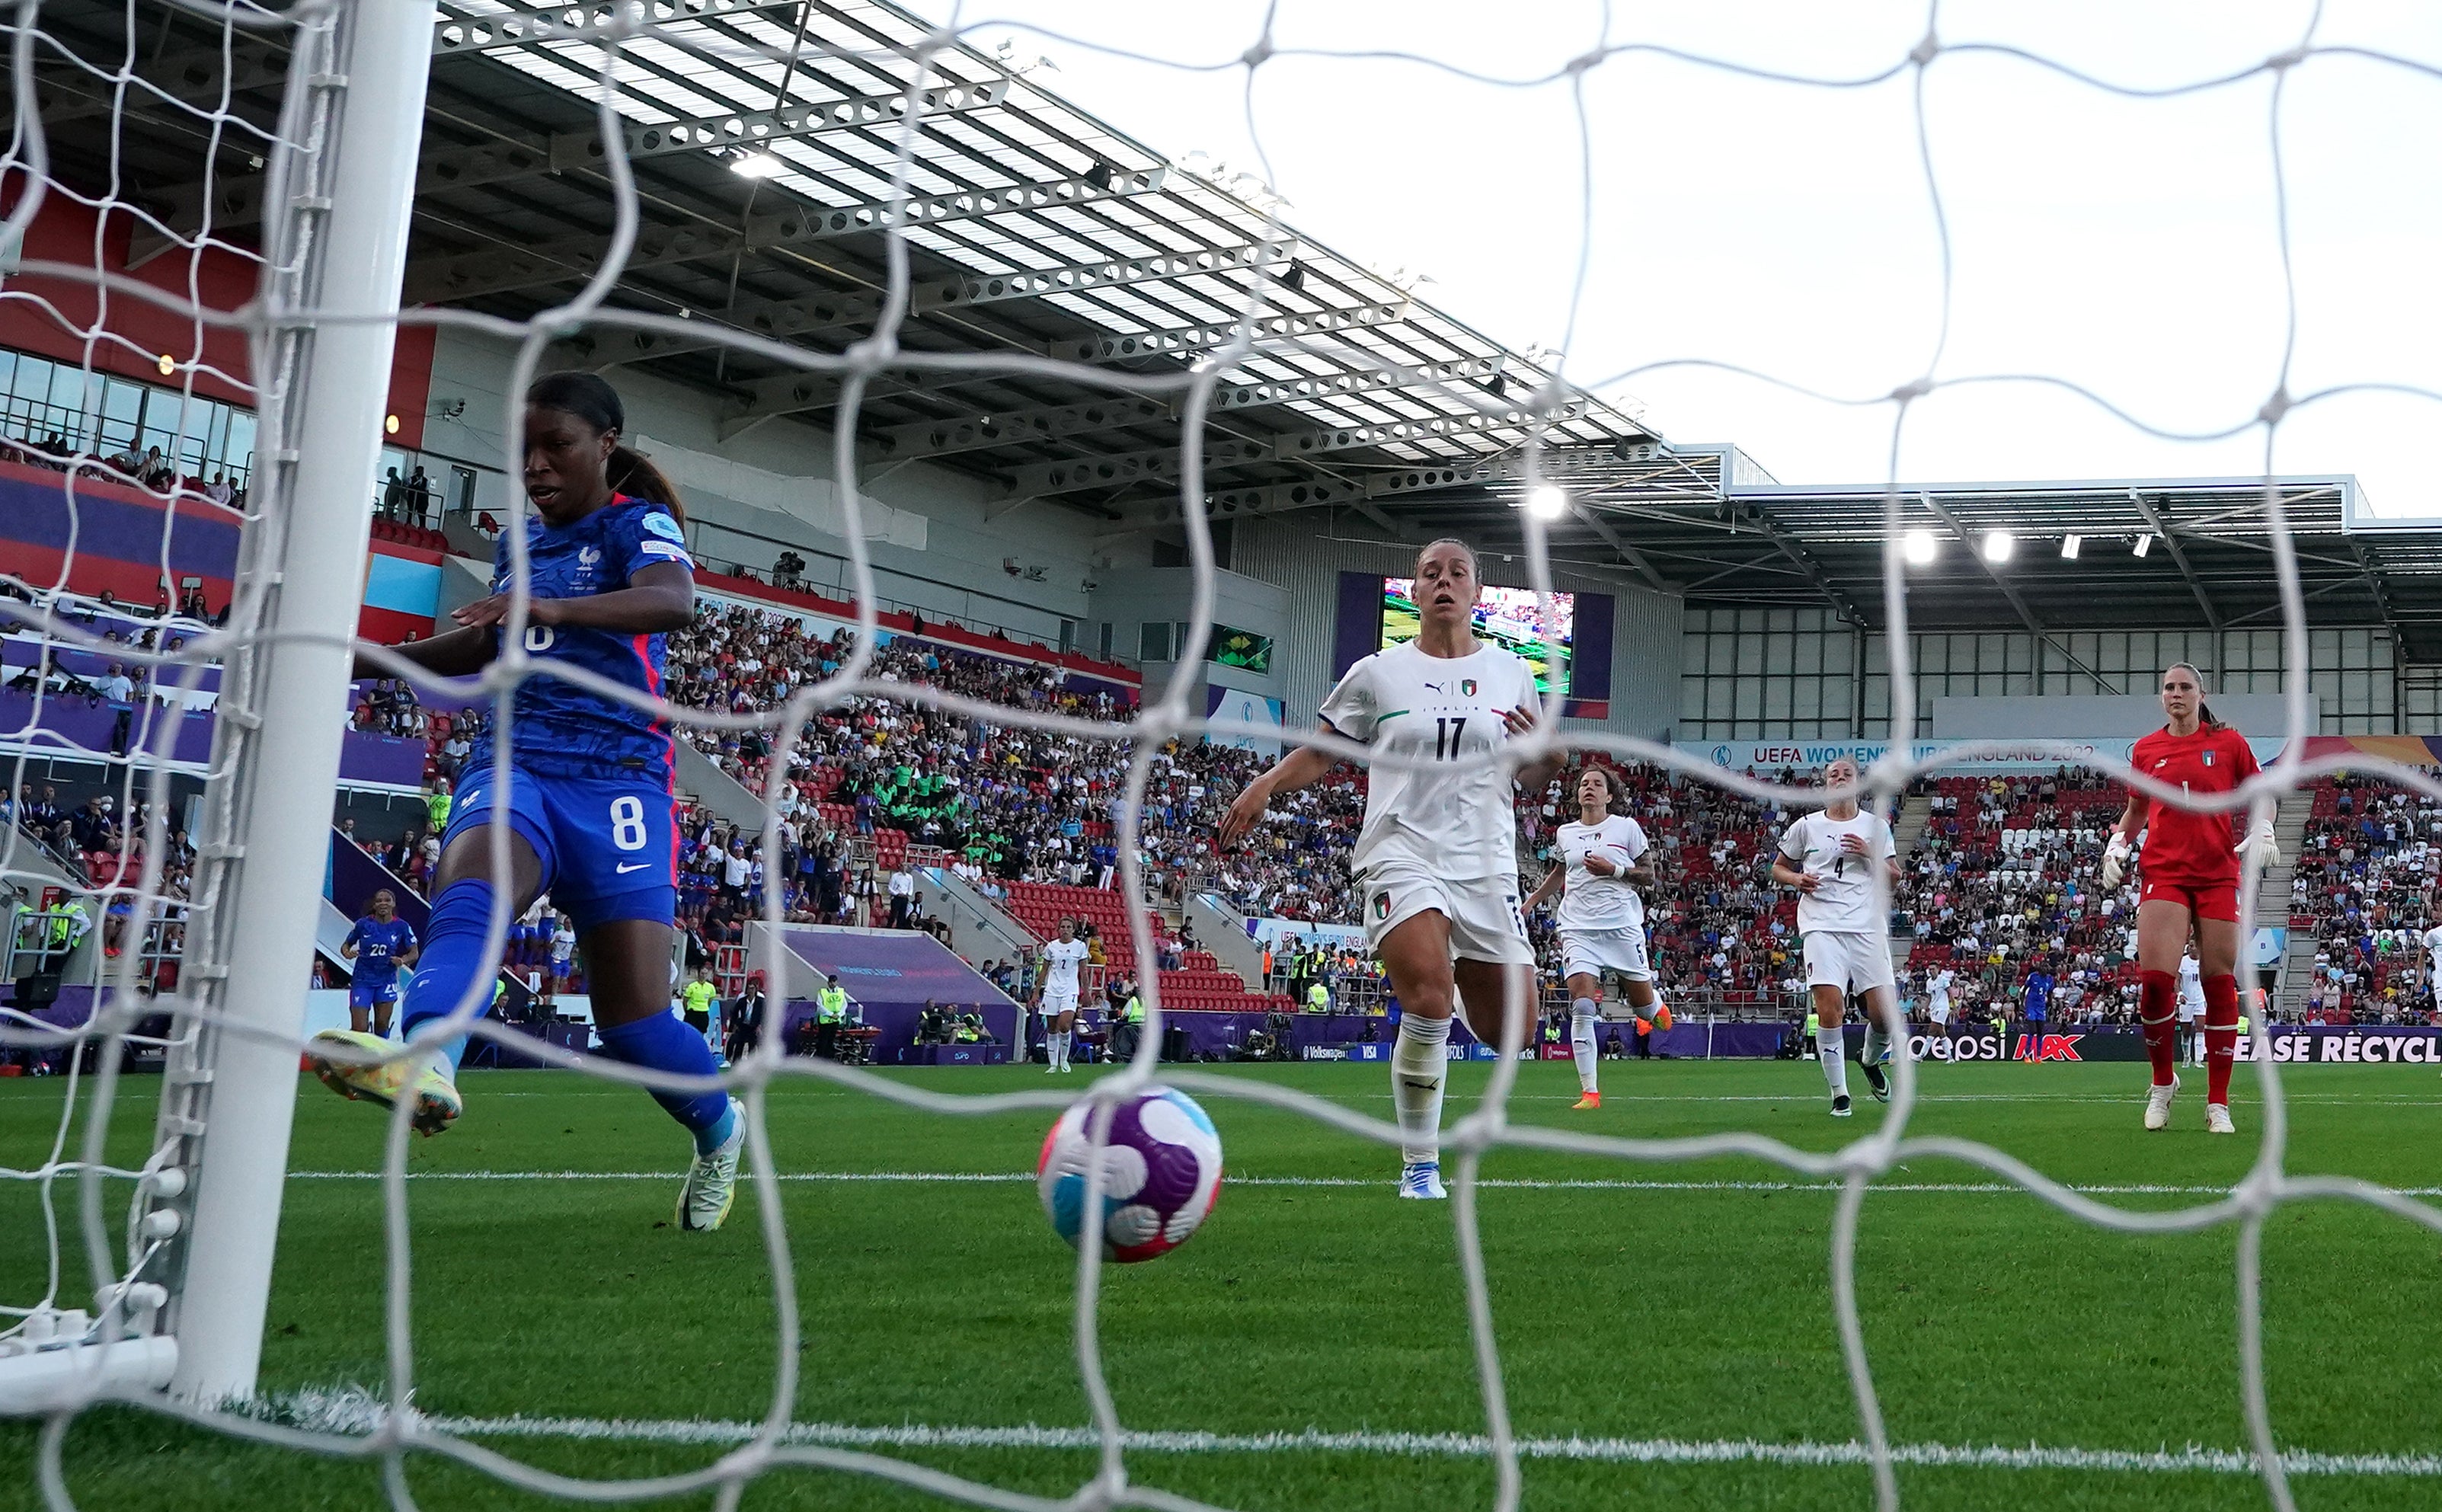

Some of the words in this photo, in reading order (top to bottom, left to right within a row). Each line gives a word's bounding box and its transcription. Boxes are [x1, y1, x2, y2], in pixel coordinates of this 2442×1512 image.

[1436, 717, 1467, 762] 17
[1754, 748, 1802, 763] UEFA
[609, 795, 647, 851] 8
[1834, 856, 1844, 880] 4
[369, 944, 387, 957] 20
[1061, 959, 1067, 970] 2
[1309, 1045, 1346, 1061] Volkswagen
[1362, 1045, 1377, 1059] VISA
[1907, 1033, 2006, 1060] pepsi
[2012, 1033, 2086, 1061] MAX
